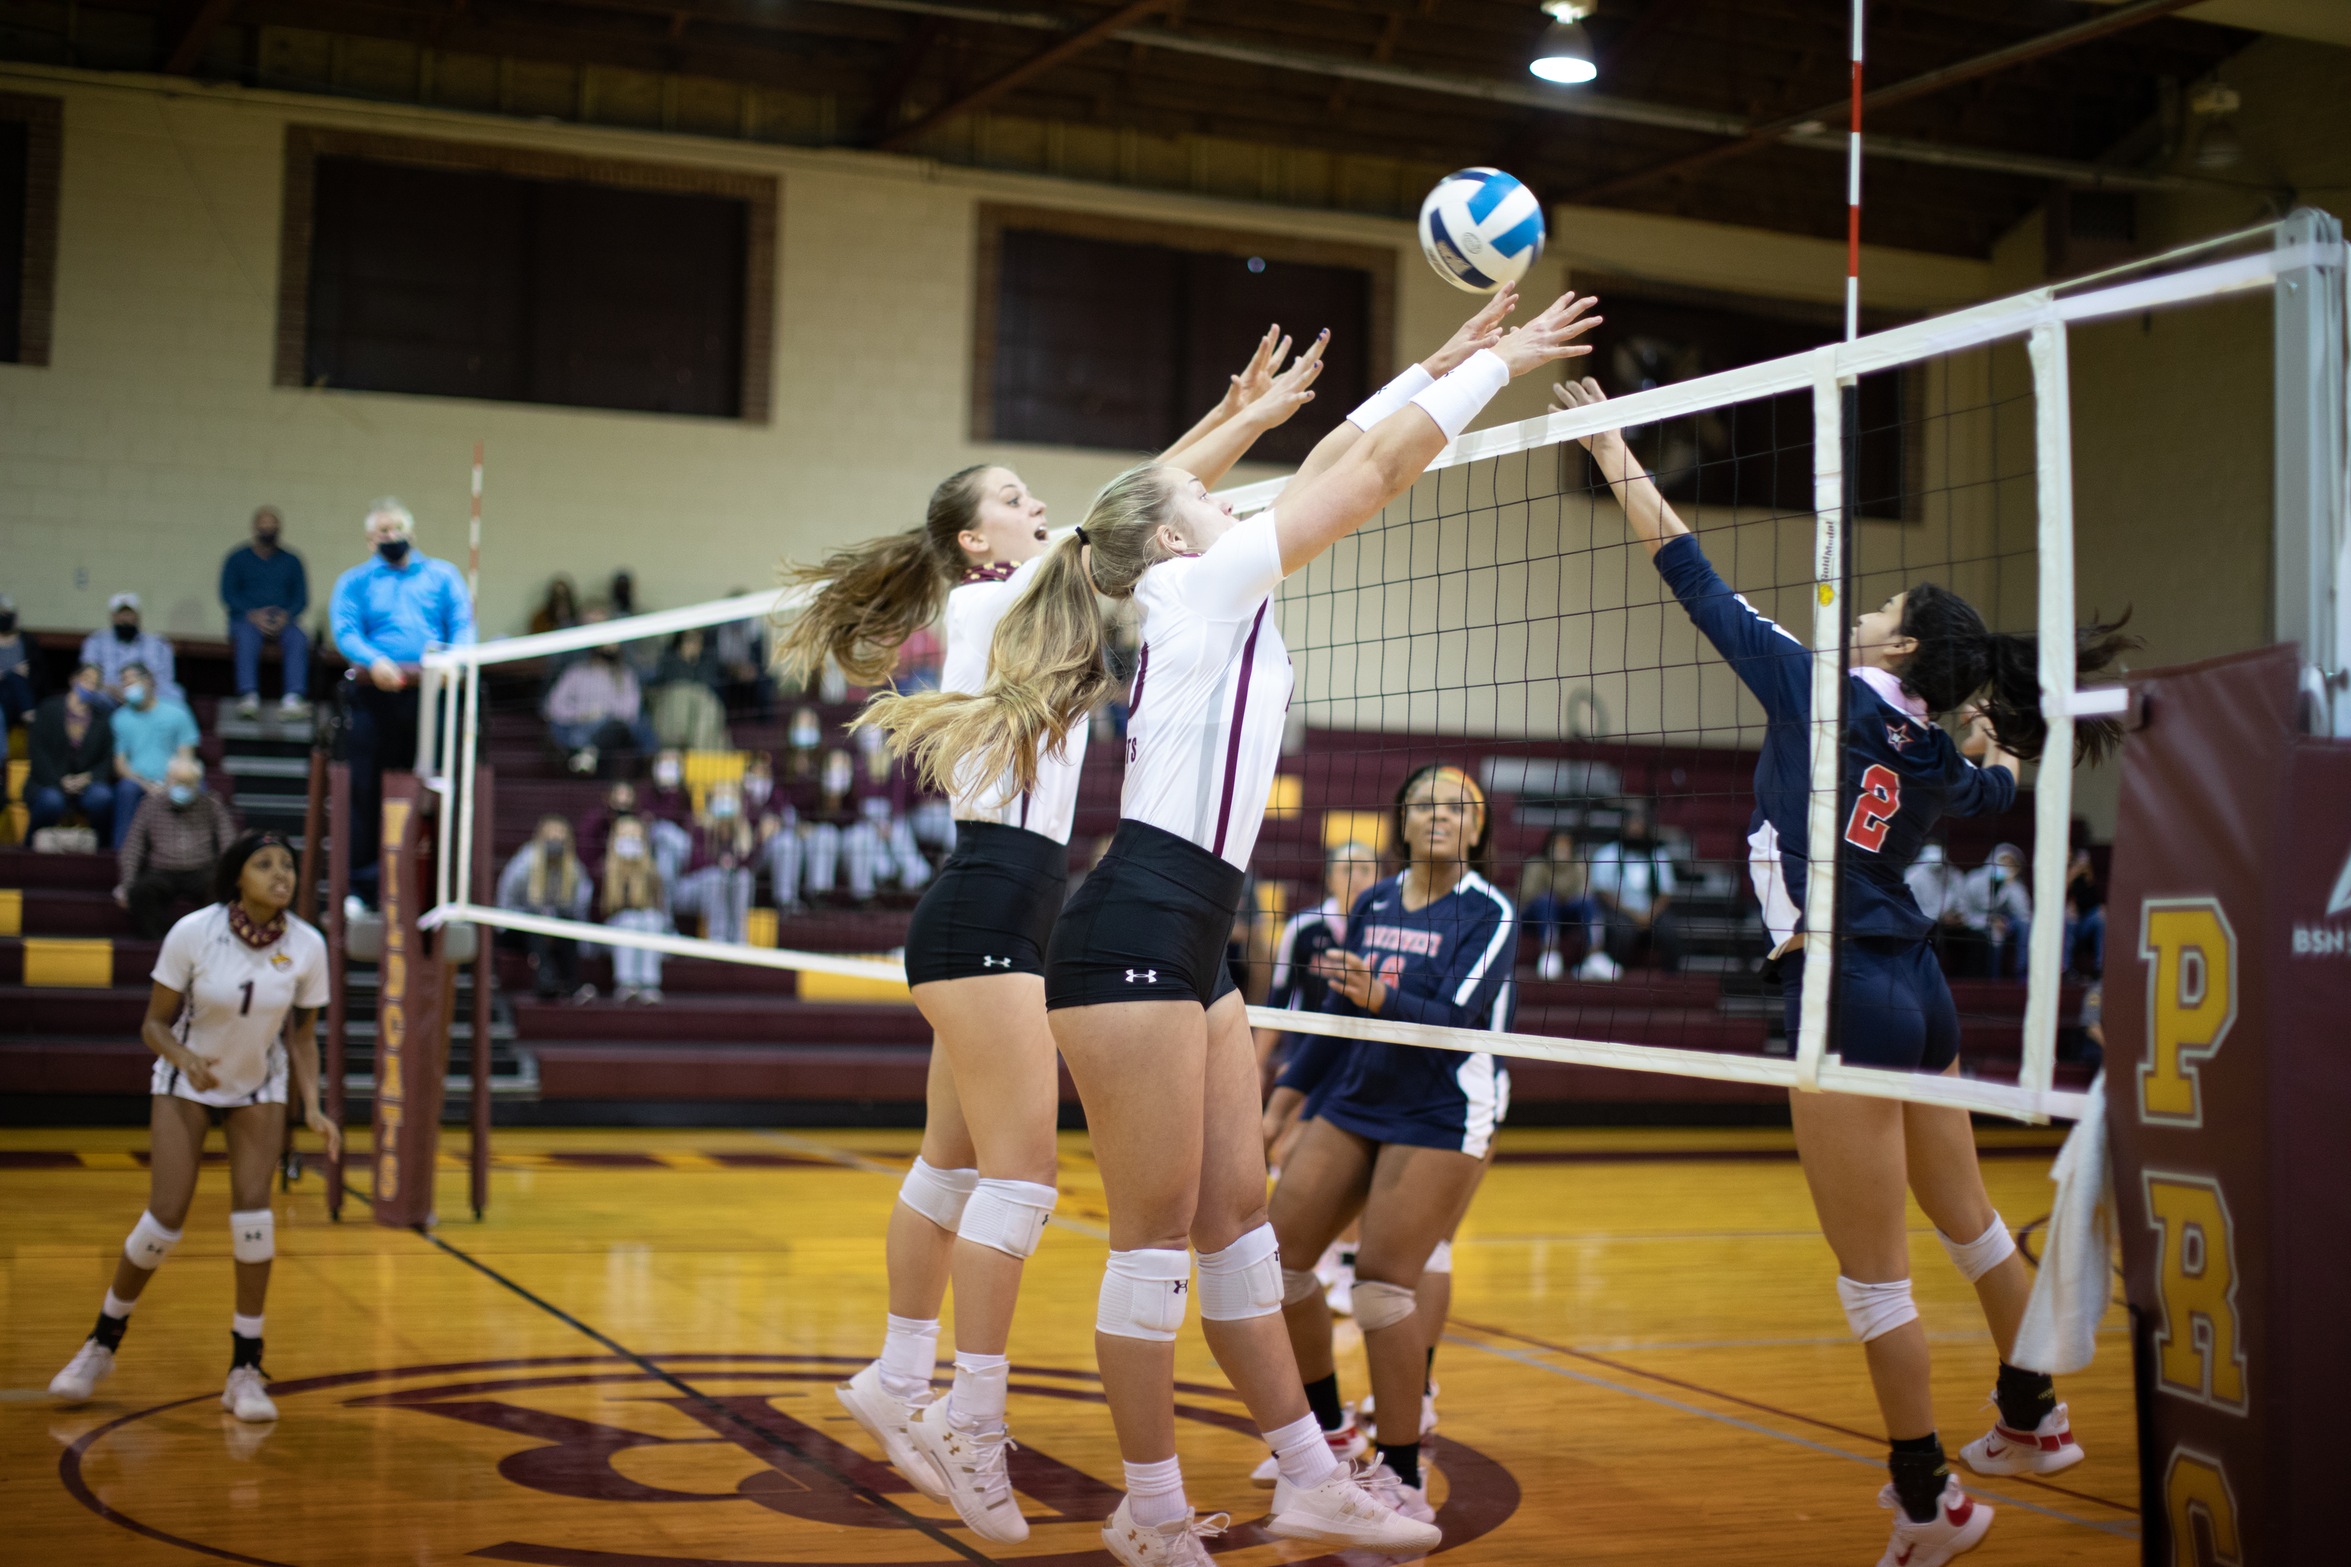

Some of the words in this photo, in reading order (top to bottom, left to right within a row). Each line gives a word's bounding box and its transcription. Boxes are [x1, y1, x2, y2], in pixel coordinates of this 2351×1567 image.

[1844, 763, 1901, 853] 2
[2291, 925, 2345, 954] BSN
[238, 981, 254, 1016] 1
